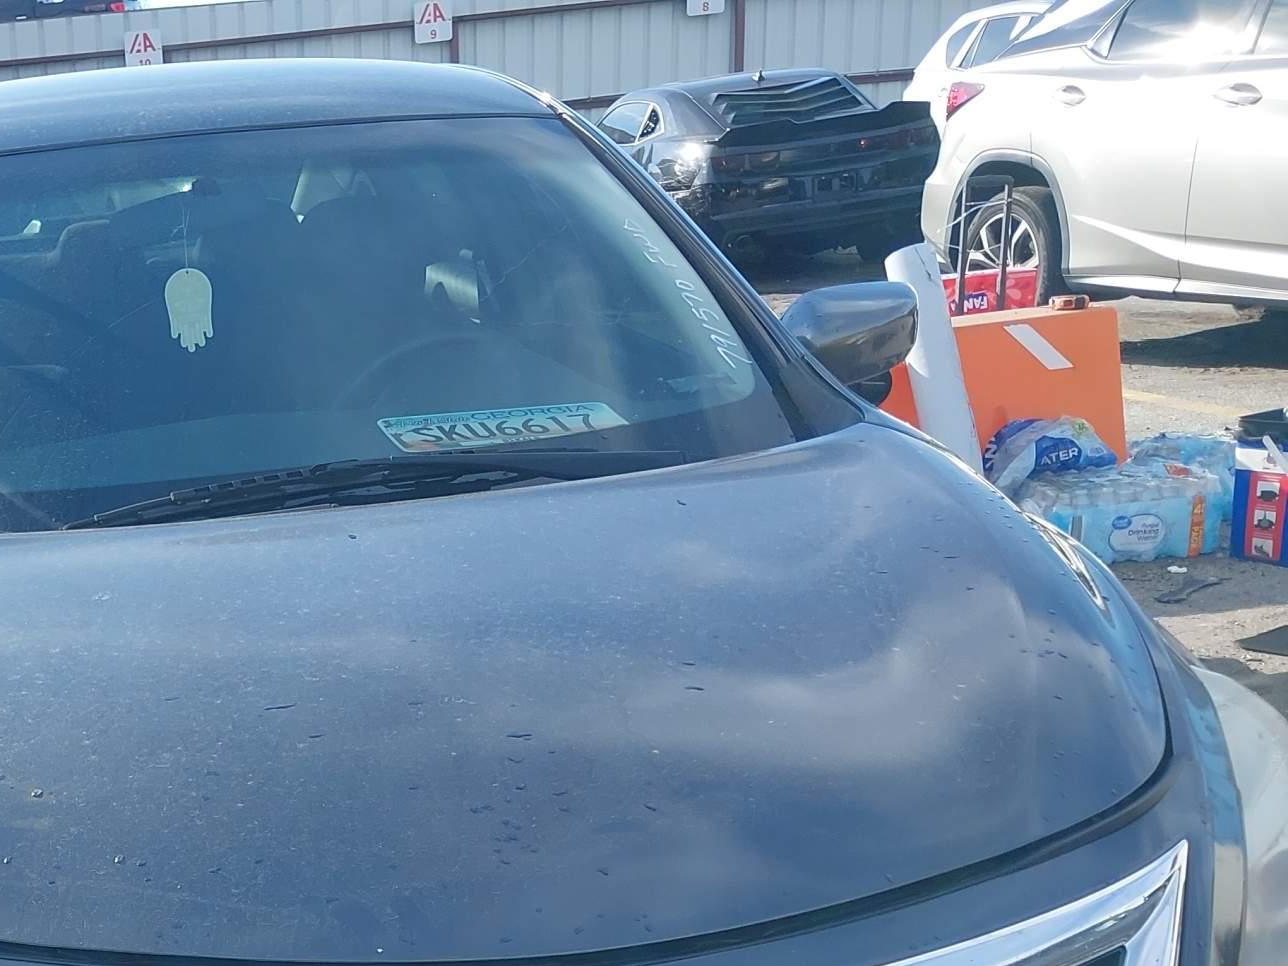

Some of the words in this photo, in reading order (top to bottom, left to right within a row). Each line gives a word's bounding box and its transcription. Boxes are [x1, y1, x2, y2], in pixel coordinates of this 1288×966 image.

[430, 30, 437, 39] 9
[469, 403, 594, 421] GEORGIA
[412, 413, 600, 443] SKU6617
